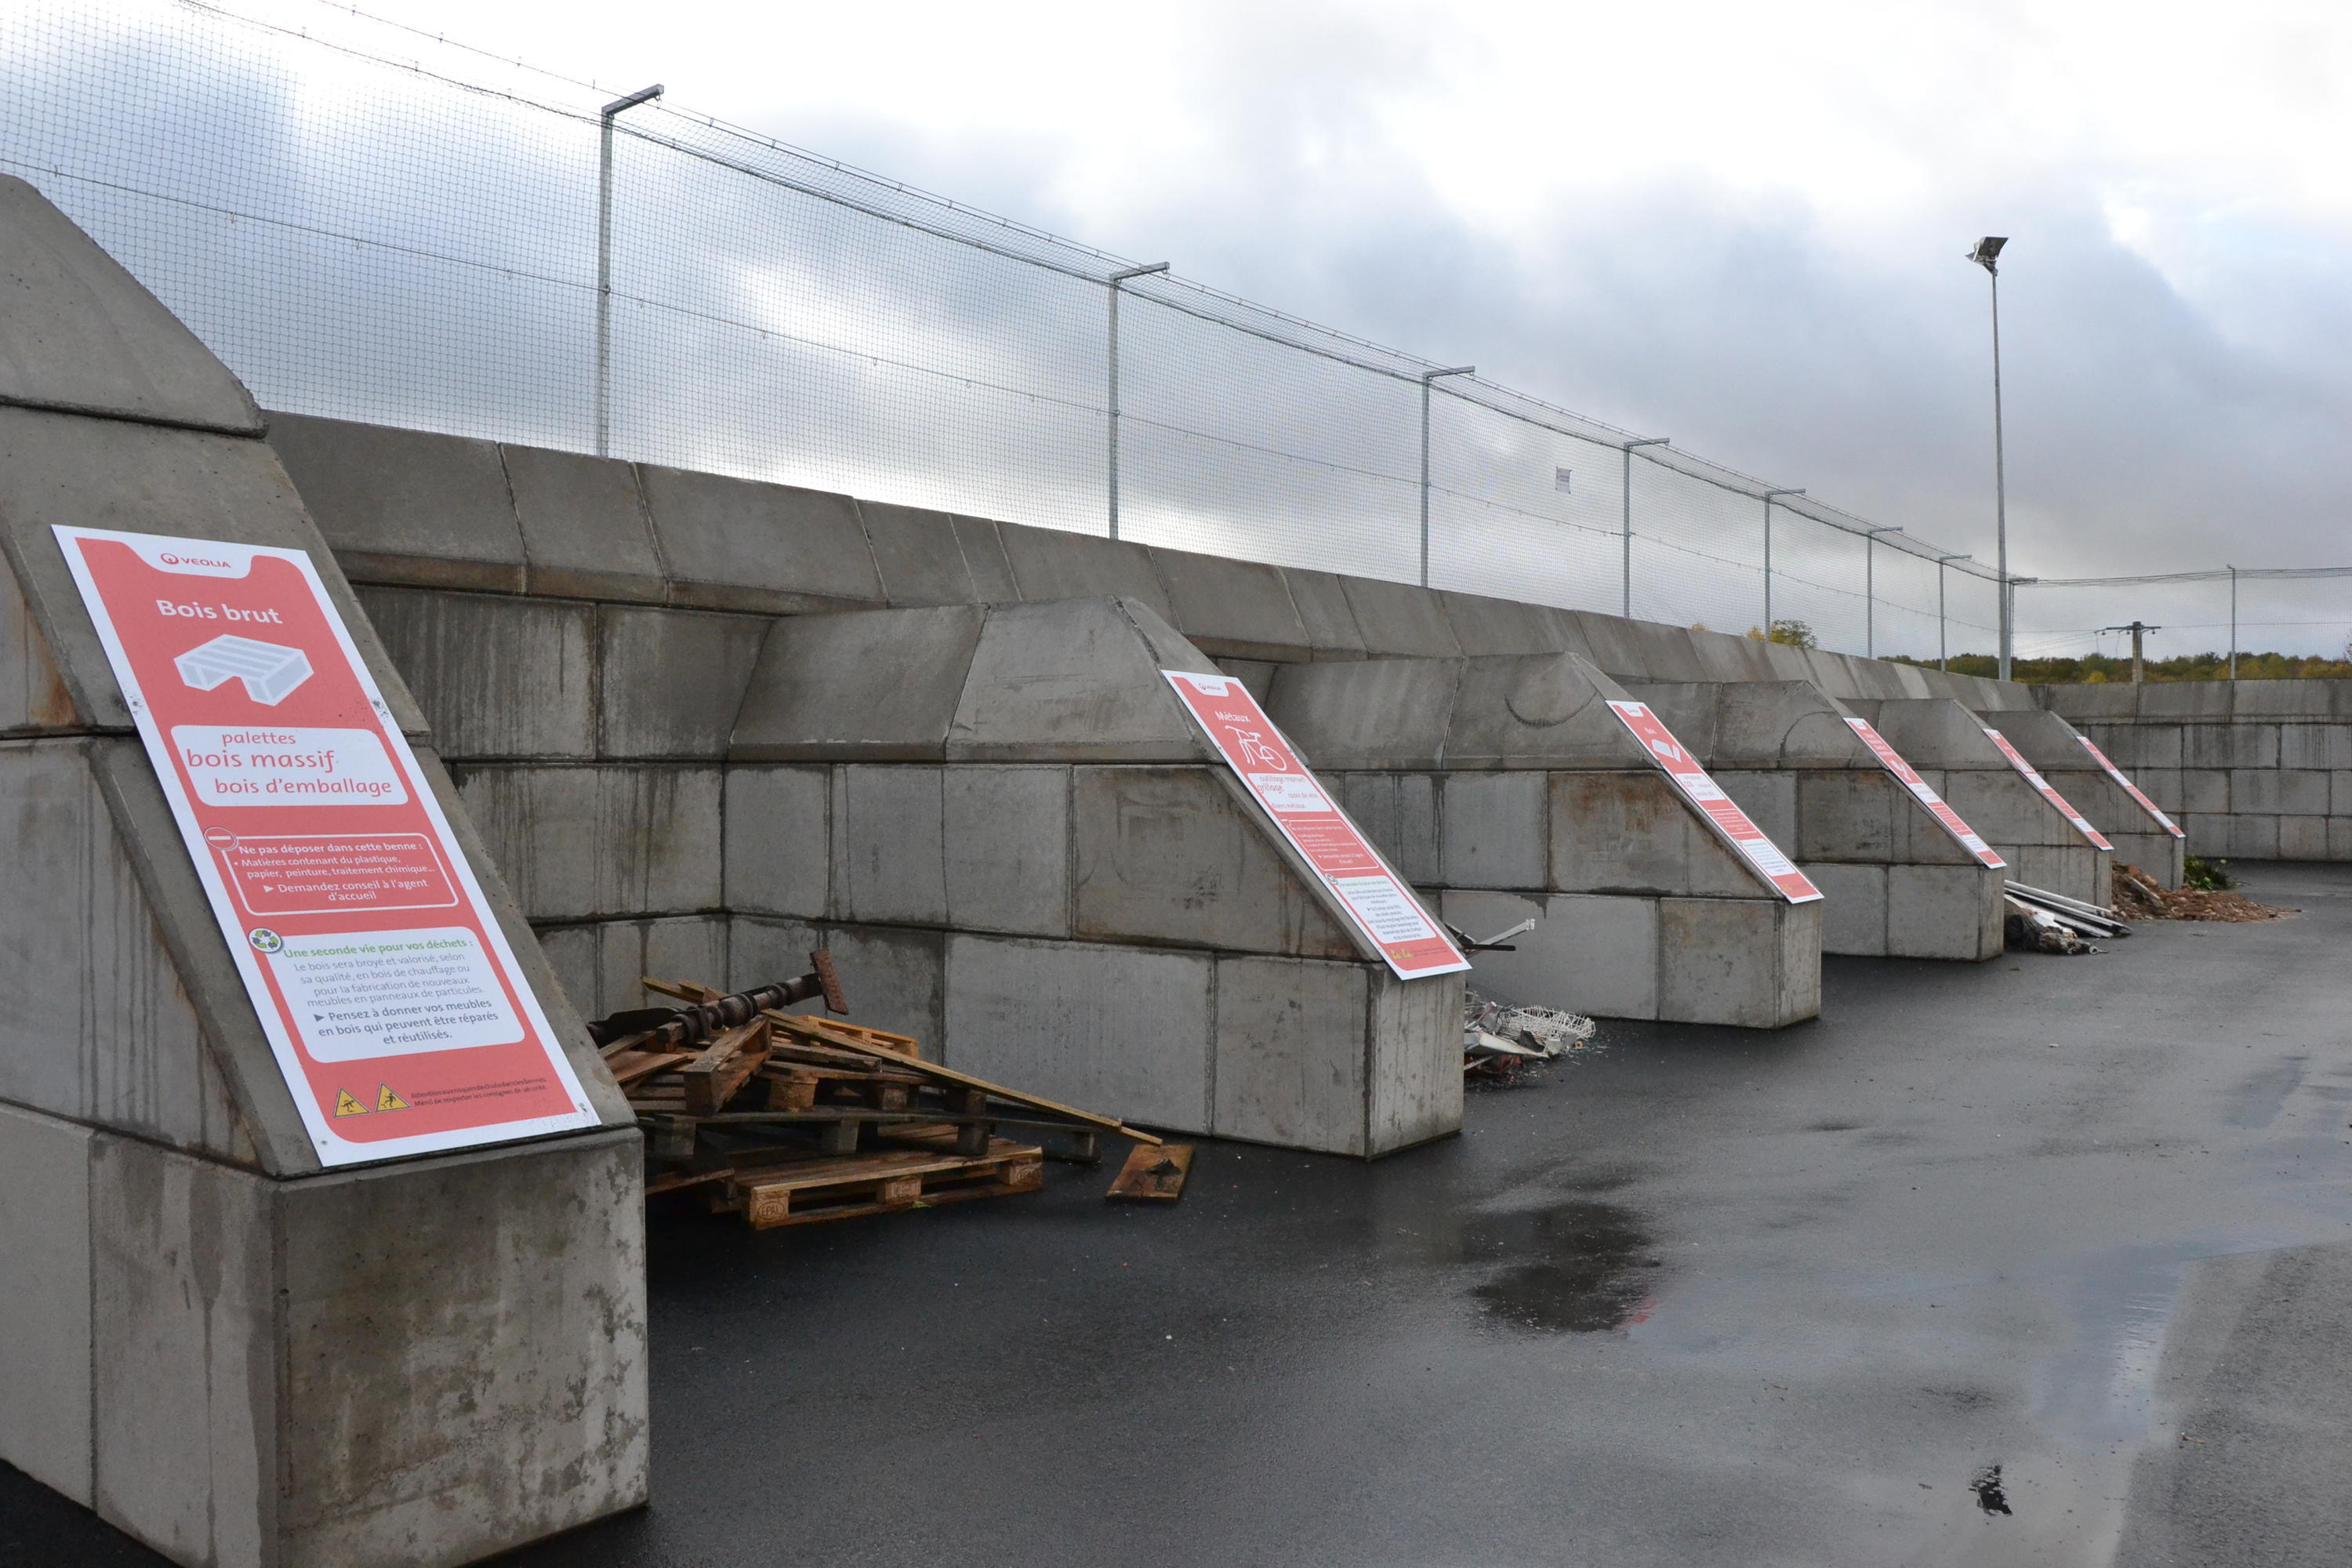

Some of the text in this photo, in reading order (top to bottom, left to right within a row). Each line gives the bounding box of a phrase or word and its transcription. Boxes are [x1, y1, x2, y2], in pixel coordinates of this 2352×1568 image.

[180, 557, 231, 568] VEOLIA
[156, 600, 283, 624] Bois brut
[1214, 711, 1251, 723] Métaux
[222, 731, 296, 747] palettes
[186, 749, 335, 773] bois massif
[214, 779, 392, 797] bois d'emballage
[238, 845, 256, 855] Ne
[258, 846, 278, 856] pas
[281, 844, 324, 855] déposer
[327, 844, 353, 852] dans
[355, 842, 383, 851] cette
[383, 842, 416, 851] benne
[241, 855, 401, 867] Matières contenant du plastique,
[247, 869, 282, 880] papier,
[285, 868, 331, 879] peinture,
[332, 866, 383, 876] traitement
[278, 879, 428, 893] Demandez conseil à l'agent
[328, 891, 376, 902] d'accueil
[283, 949, 308, 958] Une
[310, 946, 358, 956] seconde
[358, 944, 376, 953] vie
[378, 943, 403, 955] pour
[405, 942, 424, 950] vos
[426, 939, 467, 949] déchets
[294, 953, 465, 972] Le bois sera broyé et valorisé, selon
[314, 973, 355, 985] qualité,
[371, 969, 392, 979] bois
[394, 968, 407, 977] de
[408, 965, 456, 976] chauffage
[307, 985, 485, 1007] meubles en panneaux de particules.
[314, 977, 470, 998] pour la fabrication de nouveaux
[328, 999, 492, 1021] Pensez à donner vos meubles
[335, 1024, 361, 1036] bois
[364, 1022, 383, 1034] qui
[385, 1018, 433, 1033] peuvent
[434, 1016, 457, 1026] être
[459, 1011, 499, 1025] réparés
[383, 1029, 452, 1044] et réutilisés.
